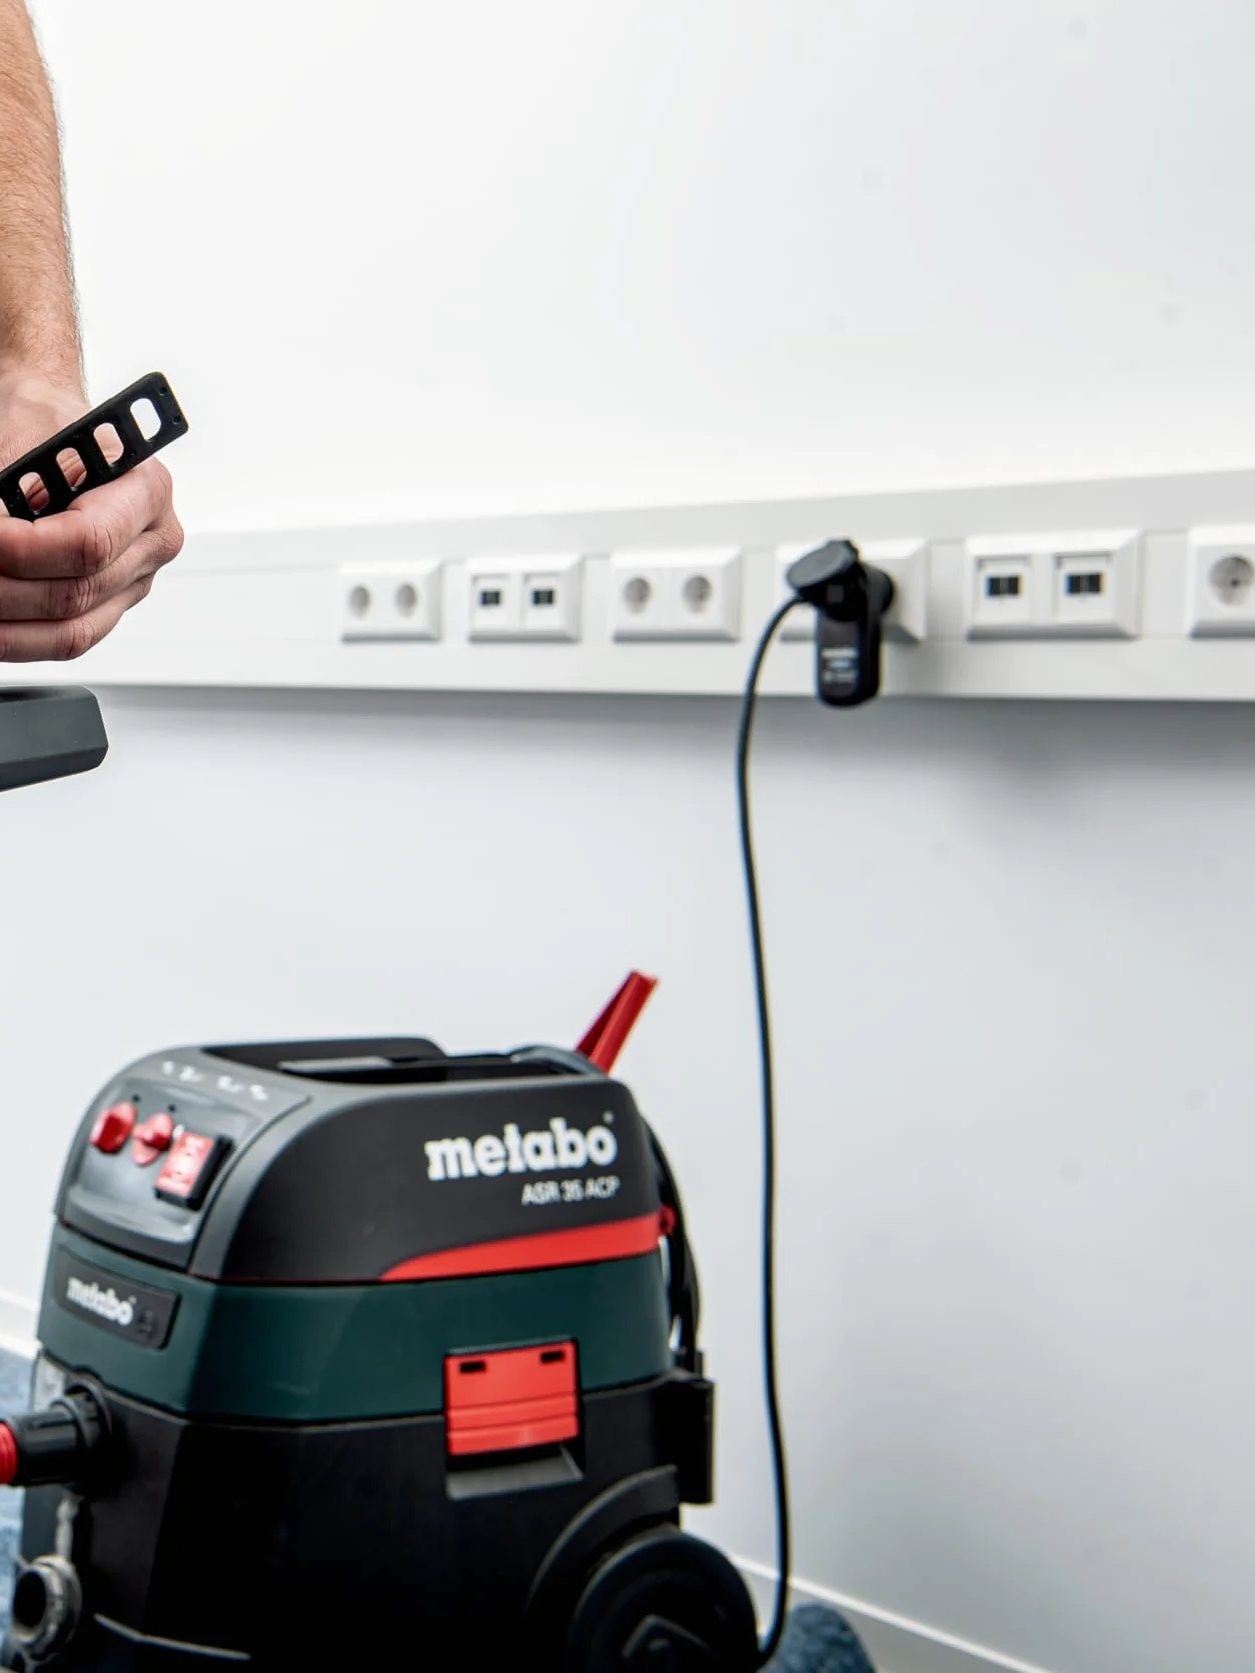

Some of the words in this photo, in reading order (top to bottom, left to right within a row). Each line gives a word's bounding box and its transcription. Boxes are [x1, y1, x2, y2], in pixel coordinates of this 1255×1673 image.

[424, 1117, 618, 1181] metabo
[521, 1181, 561, 1206] ASR
[584, 1175, 620, 1199] ACP
[67, 1277, 134, 1326] metabo
